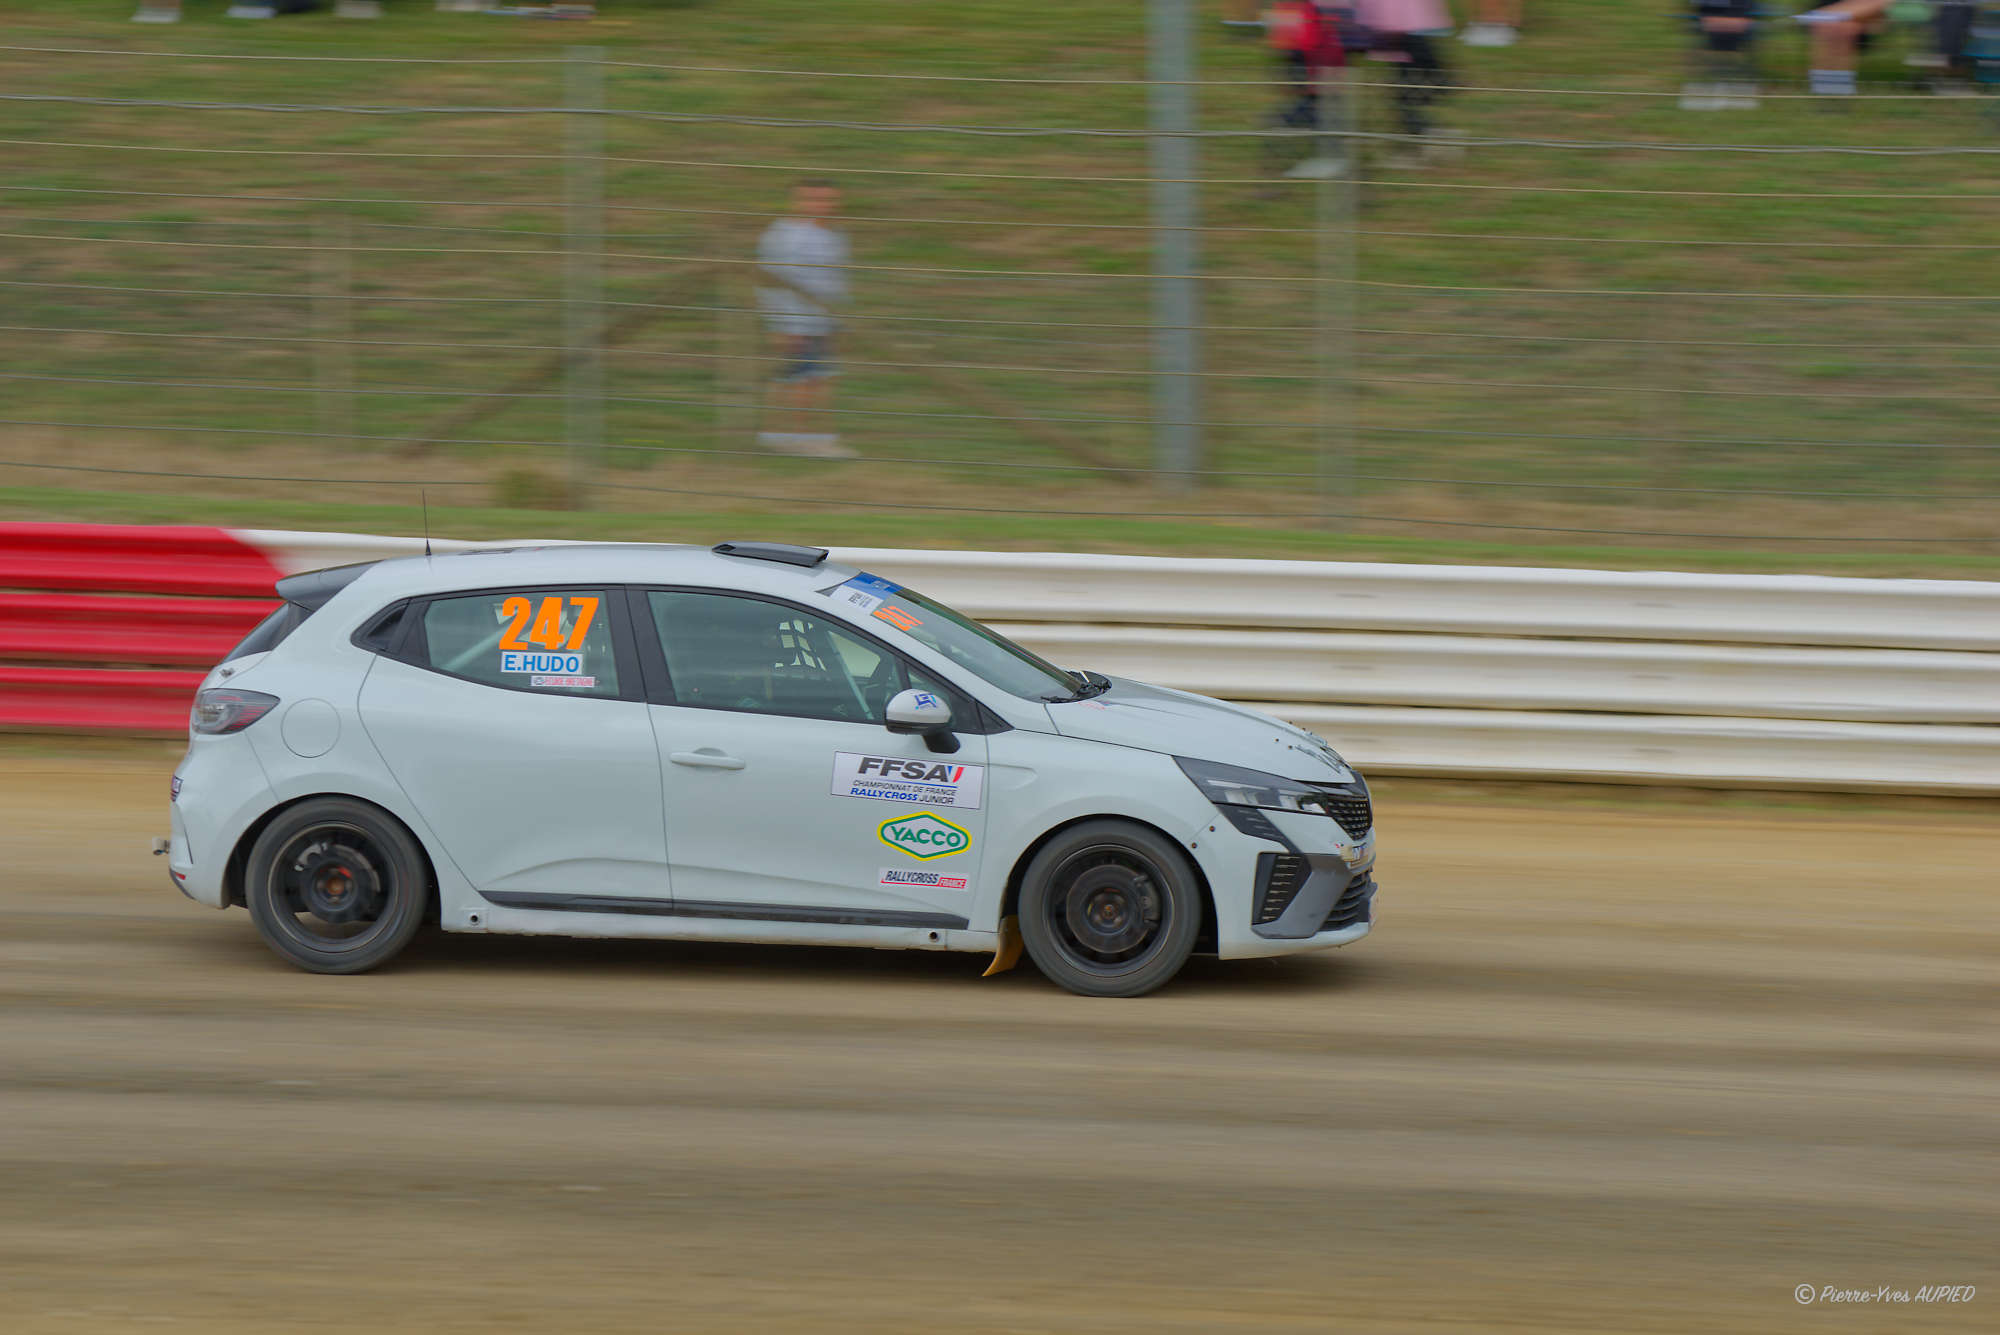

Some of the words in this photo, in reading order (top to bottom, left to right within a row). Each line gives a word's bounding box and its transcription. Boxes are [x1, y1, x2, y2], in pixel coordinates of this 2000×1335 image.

[498, 596, 599, 650] 247
[504, 654, 580, 673] E.HUDO
[857, 756, 948, 783] FFSA
[850, 787, 918, 801] RALLYCROSS
[919, 795, 955, 805] JUNIOR
[852, 780, 912, 793] CHAMPIONNAT
[912, 785, 925, 793] DE
[925, 786, 957, 797] FRANCE
[890, 825, 961, 848] YACCO
[885, 870, 939, 885] RALLYCROSS
